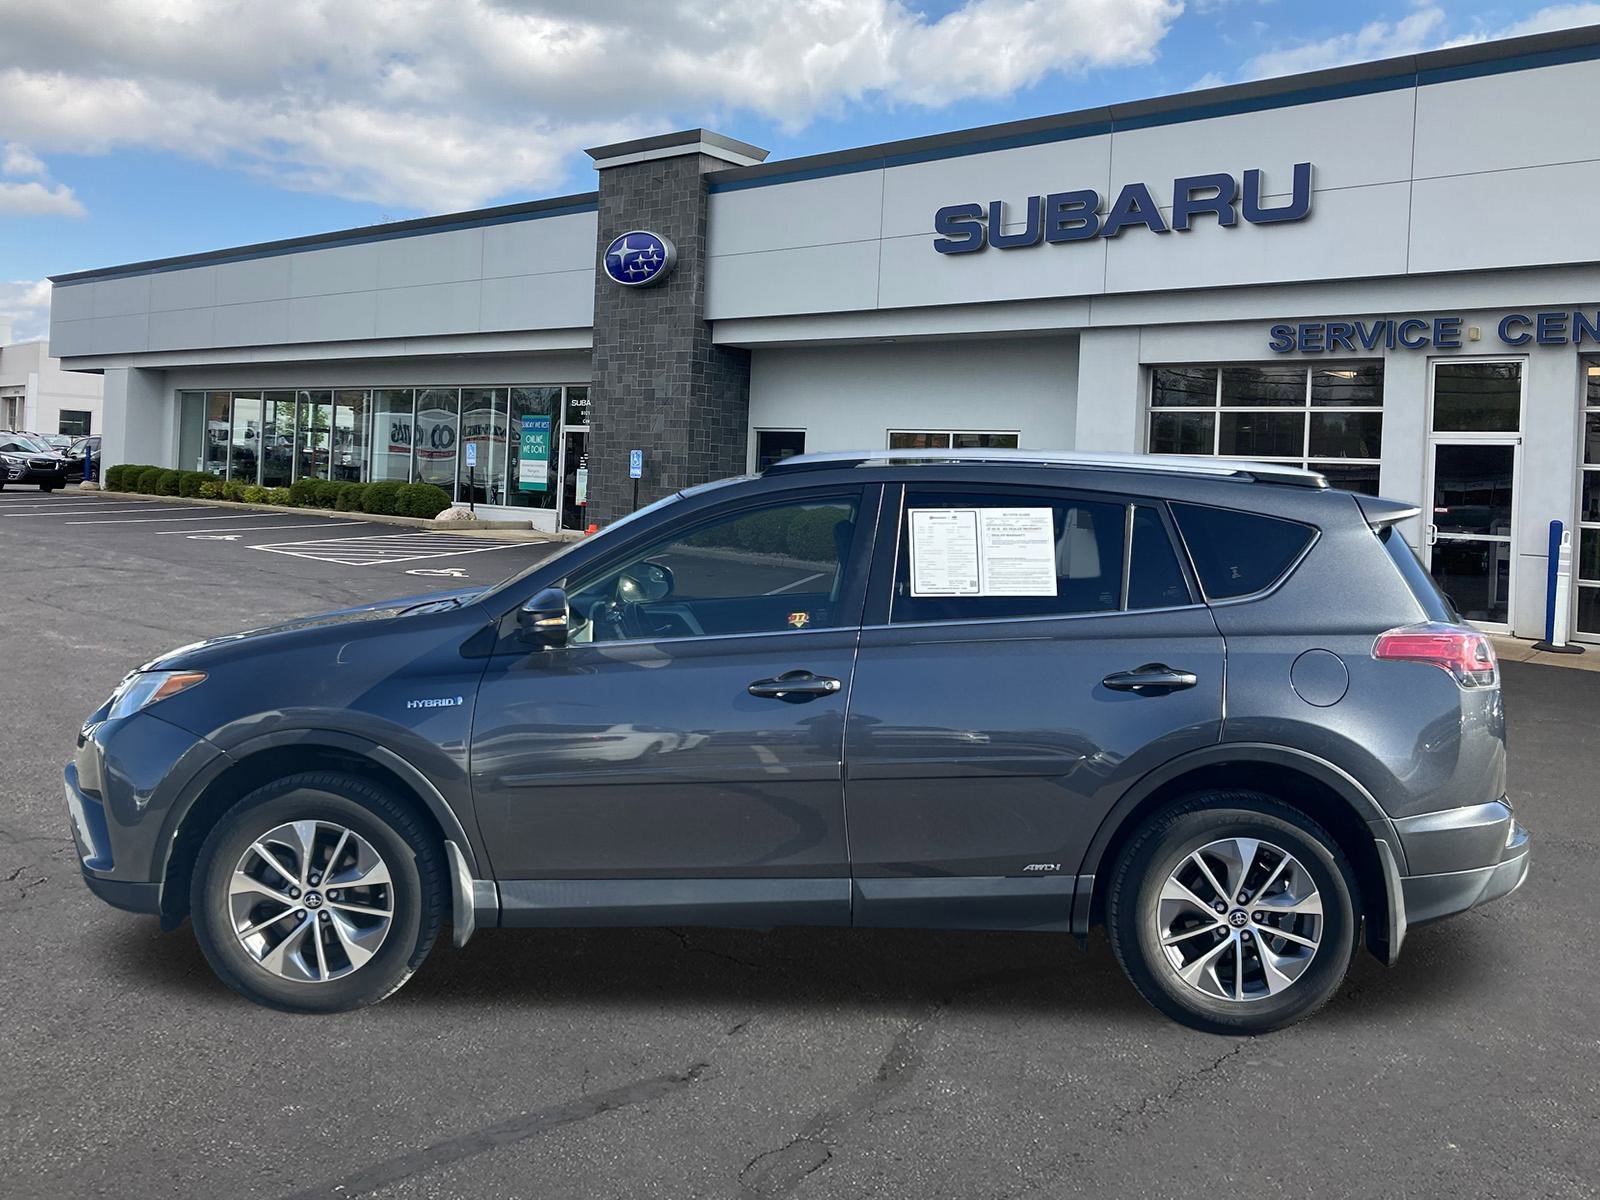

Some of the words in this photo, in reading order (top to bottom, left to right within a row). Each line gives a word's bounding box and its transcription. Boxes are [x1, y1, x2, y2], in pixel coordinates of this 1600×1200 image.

[933, 162, 1313, 255] SUBARU
[1268, 317, 1463, 353] SERVICE
[1497, 311, 1600, 346] CEN
[407, 698, 455, 709] HYBRID
